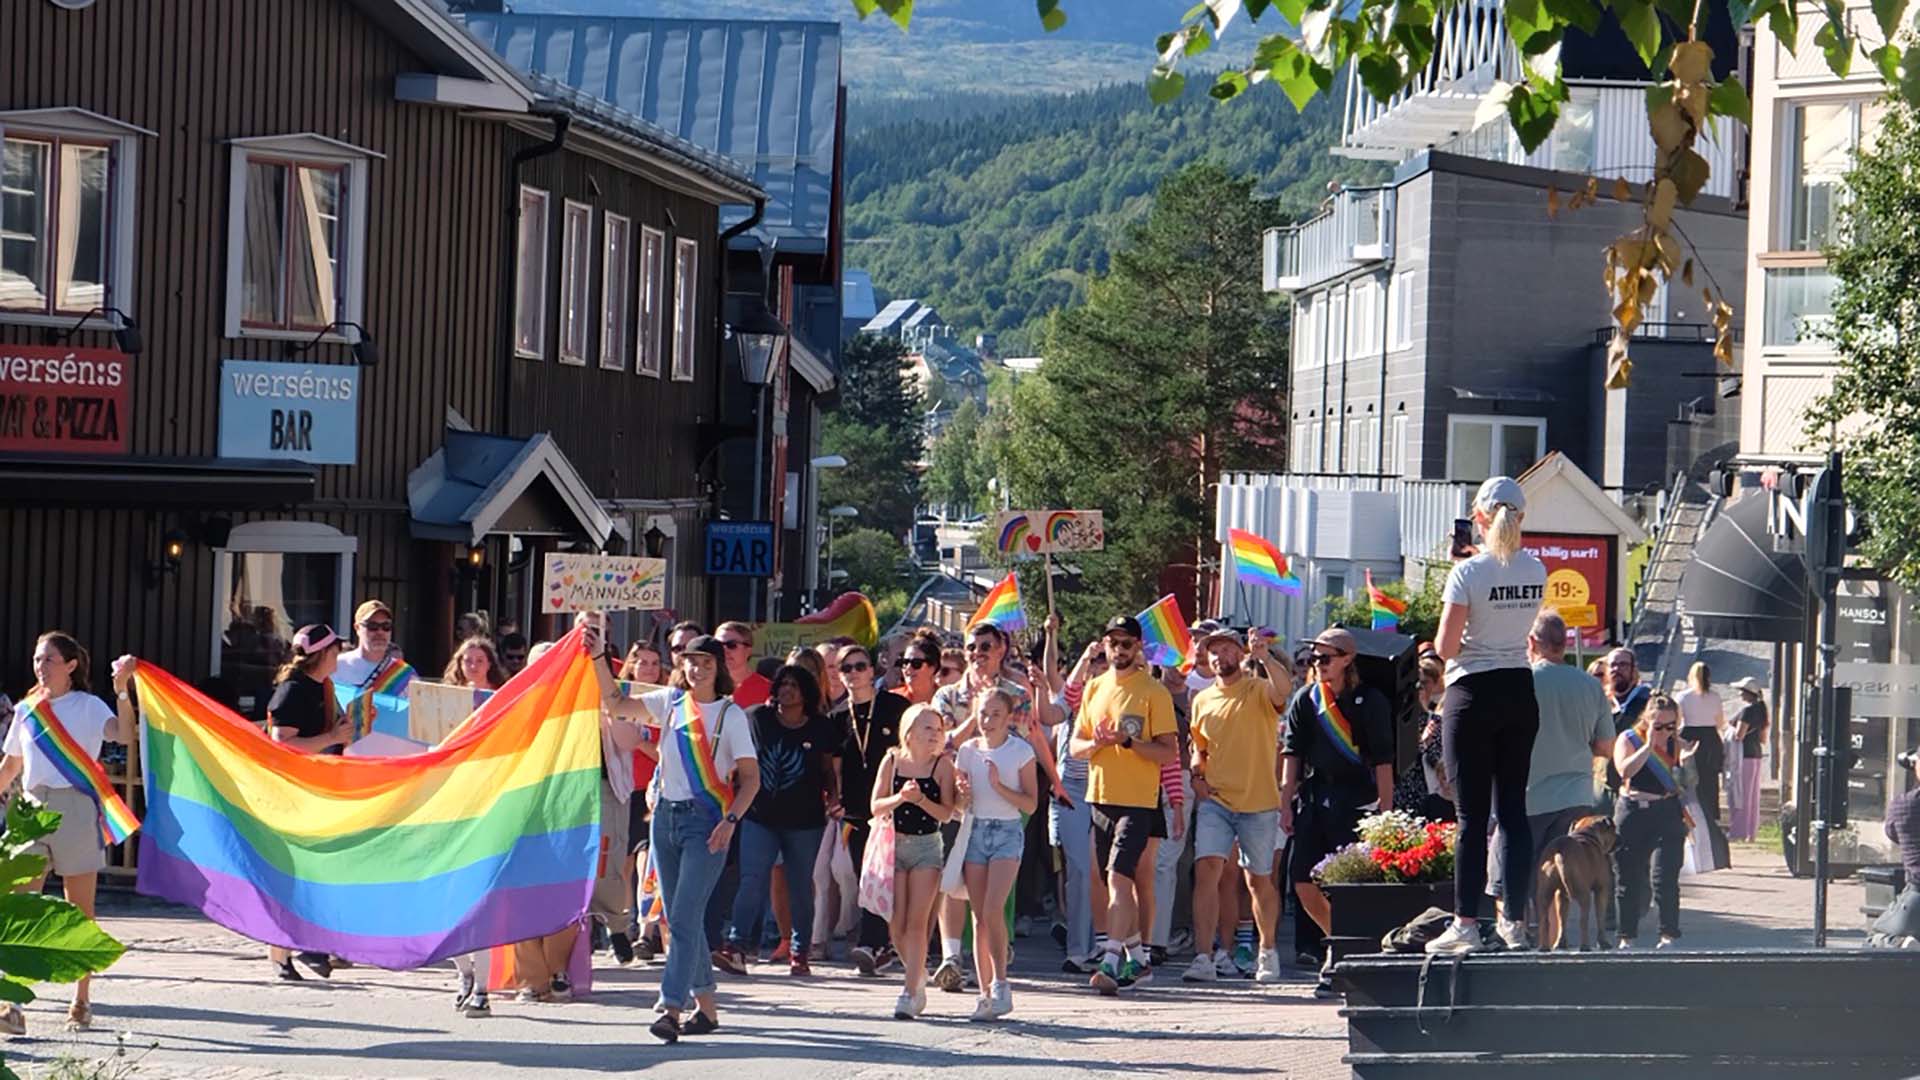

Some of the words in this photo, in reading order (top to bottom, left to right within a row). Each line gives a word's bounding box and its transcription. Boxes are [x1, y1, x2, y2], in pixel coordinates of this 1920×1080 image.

[232, 369, 353, 400] wersén:s
[0, 393, 27, 439] AT
[32, 395, 51, 439] &
[55, 396, 119, 441] PIZZA
[270, 408, 313, 451] BAR
[711, 539, 768, 572] BAR
[1541, 546, 1569, 560] billig
[1570, 547, 1598, 559] surf!
[1552, 581, 1584, 598] 19:-
